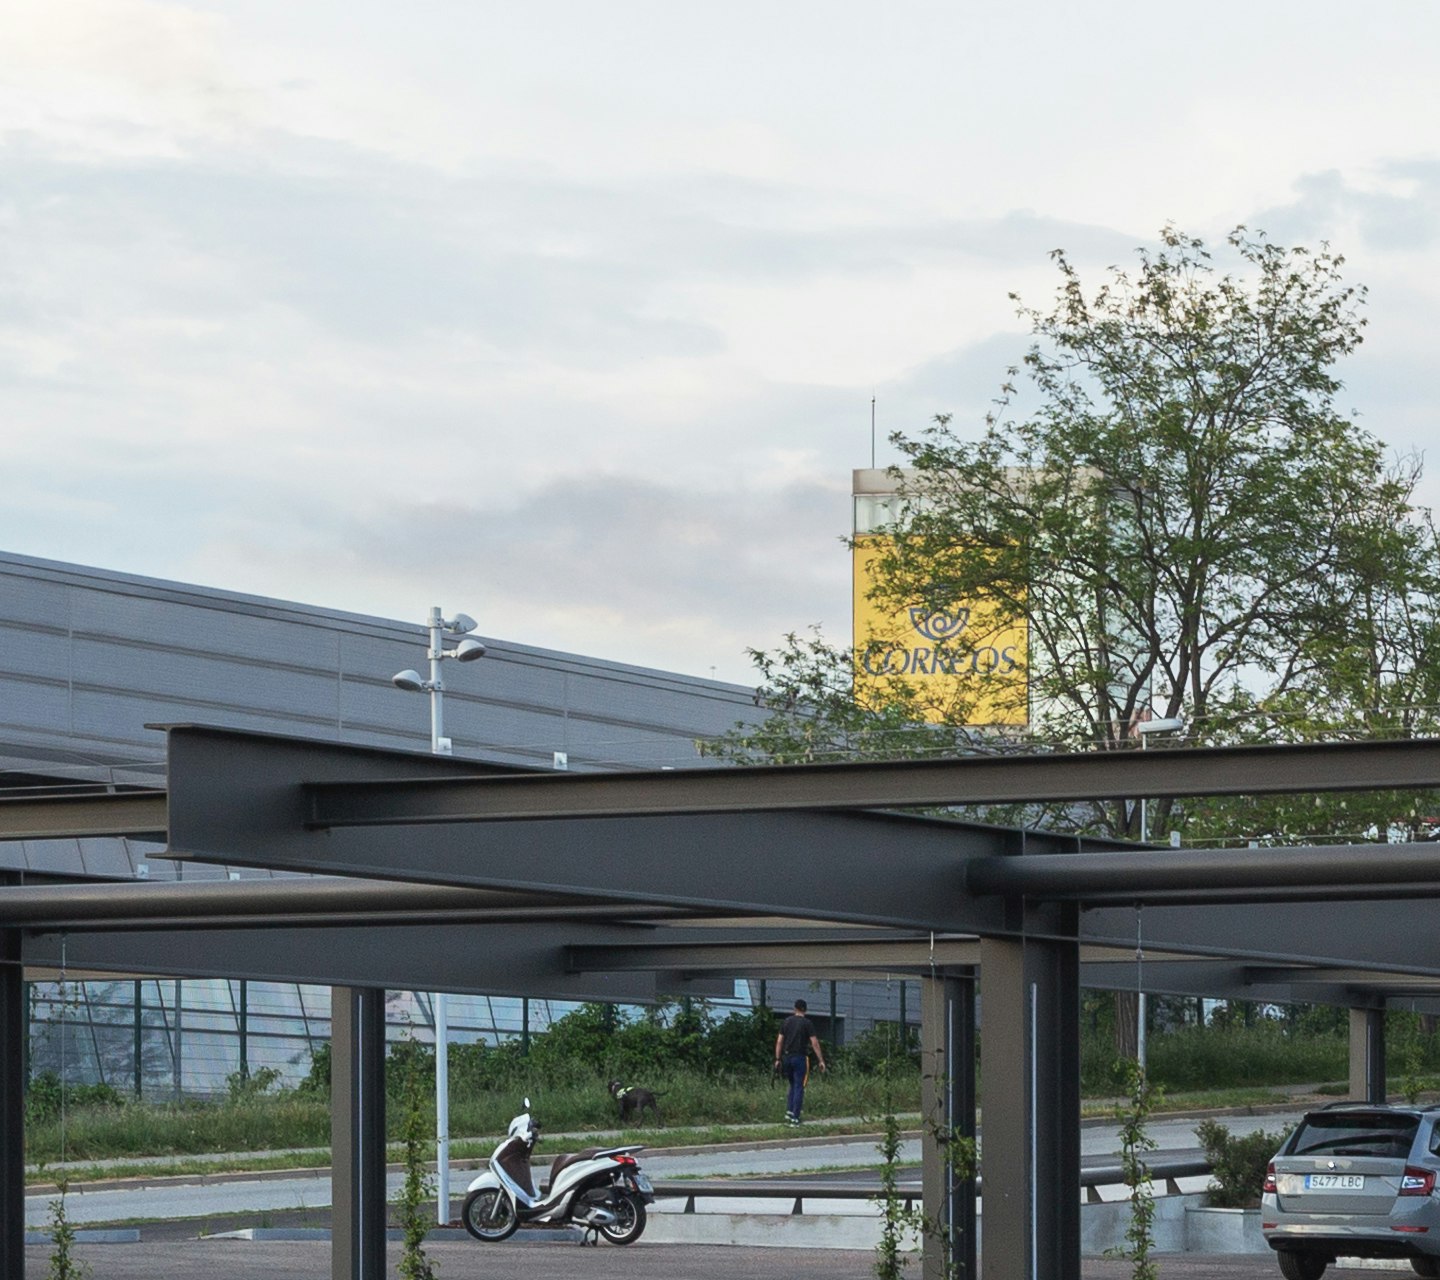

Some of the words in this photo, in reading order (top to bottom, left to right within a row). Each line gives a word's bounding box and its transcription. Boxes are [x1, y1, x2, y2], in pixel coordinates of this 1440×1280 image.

[863, 646, 1017, 676] CORREOS
[1311, 1175, 1337, 1187] 5477
[1341, 1176, 1361, 1188] LBC
